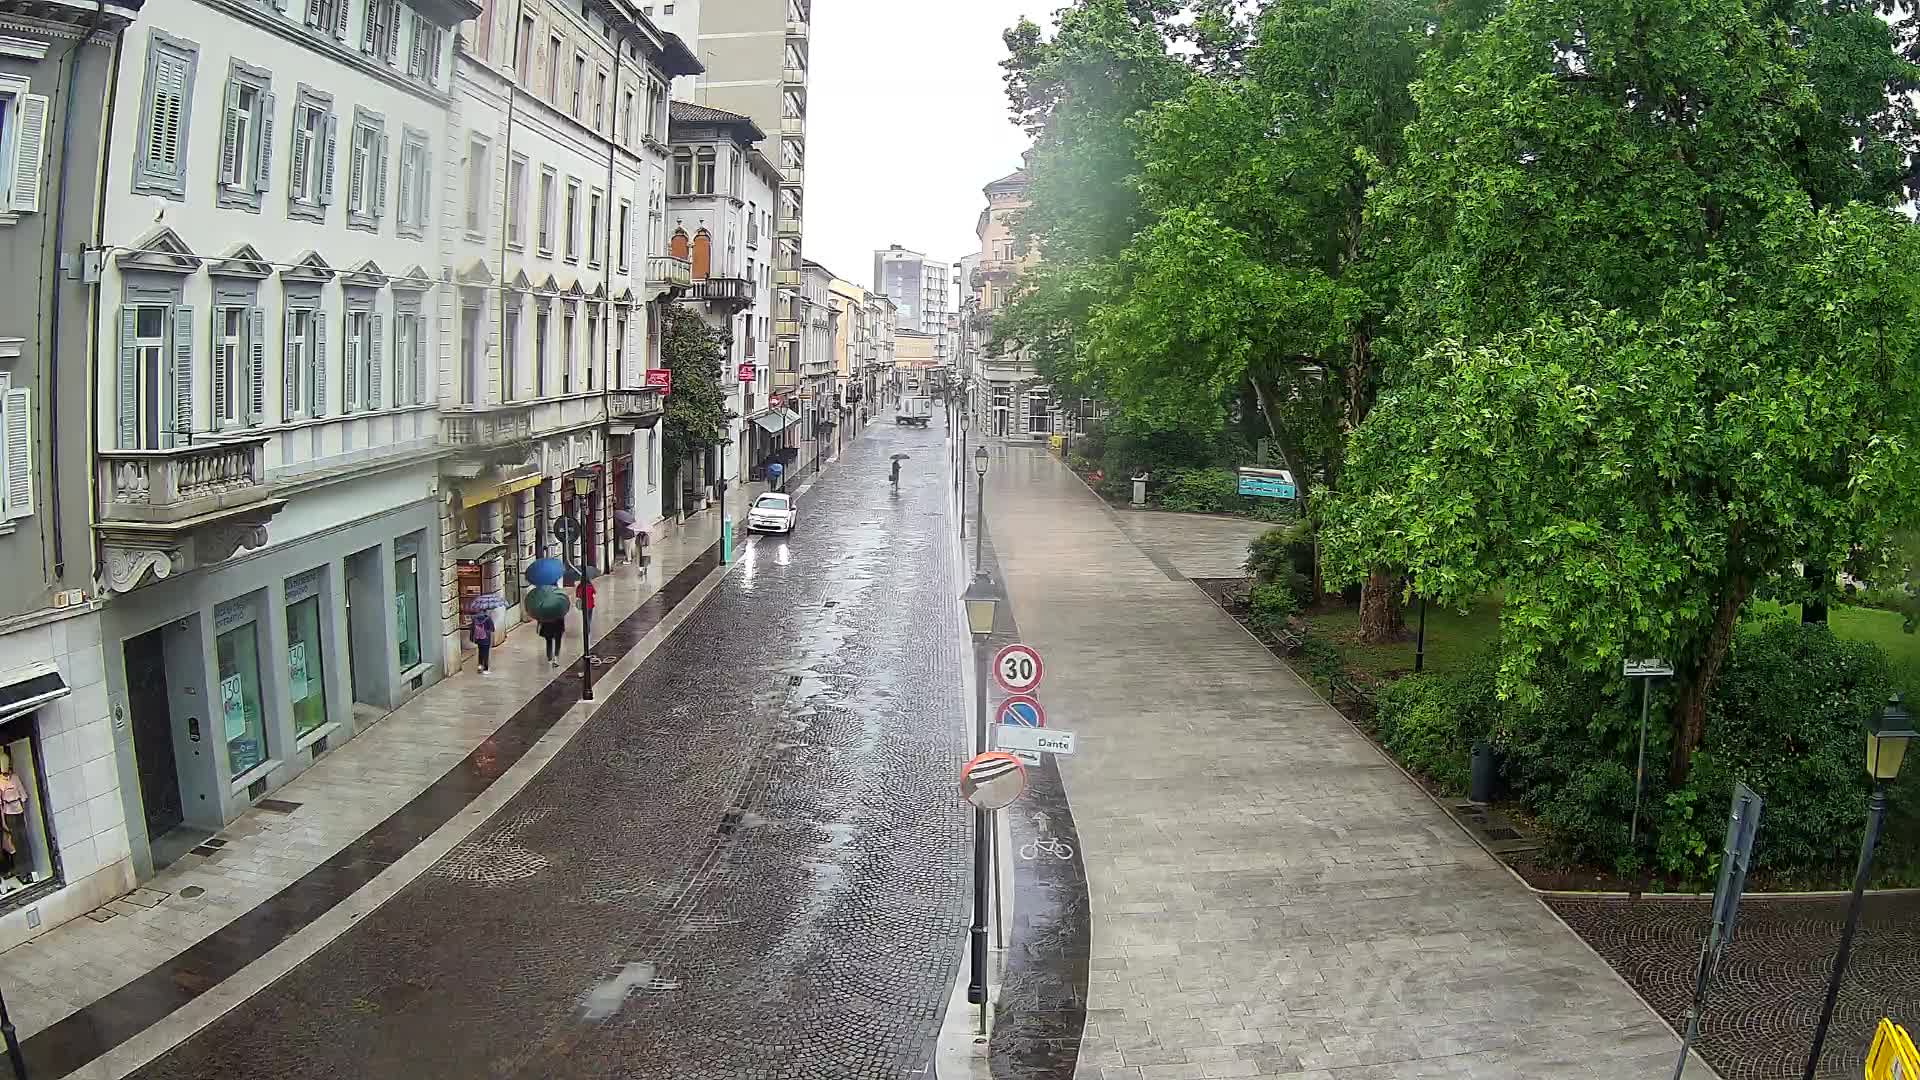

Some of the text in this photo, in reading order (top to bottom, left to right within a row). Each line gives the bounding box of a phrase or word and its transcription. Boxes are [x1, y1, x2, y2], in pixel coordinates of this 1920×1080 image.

[1005, 658, 1033, 680] 30
[222, 677, 240, 701] 130
[1038, 738, 1069, 749] Dante
